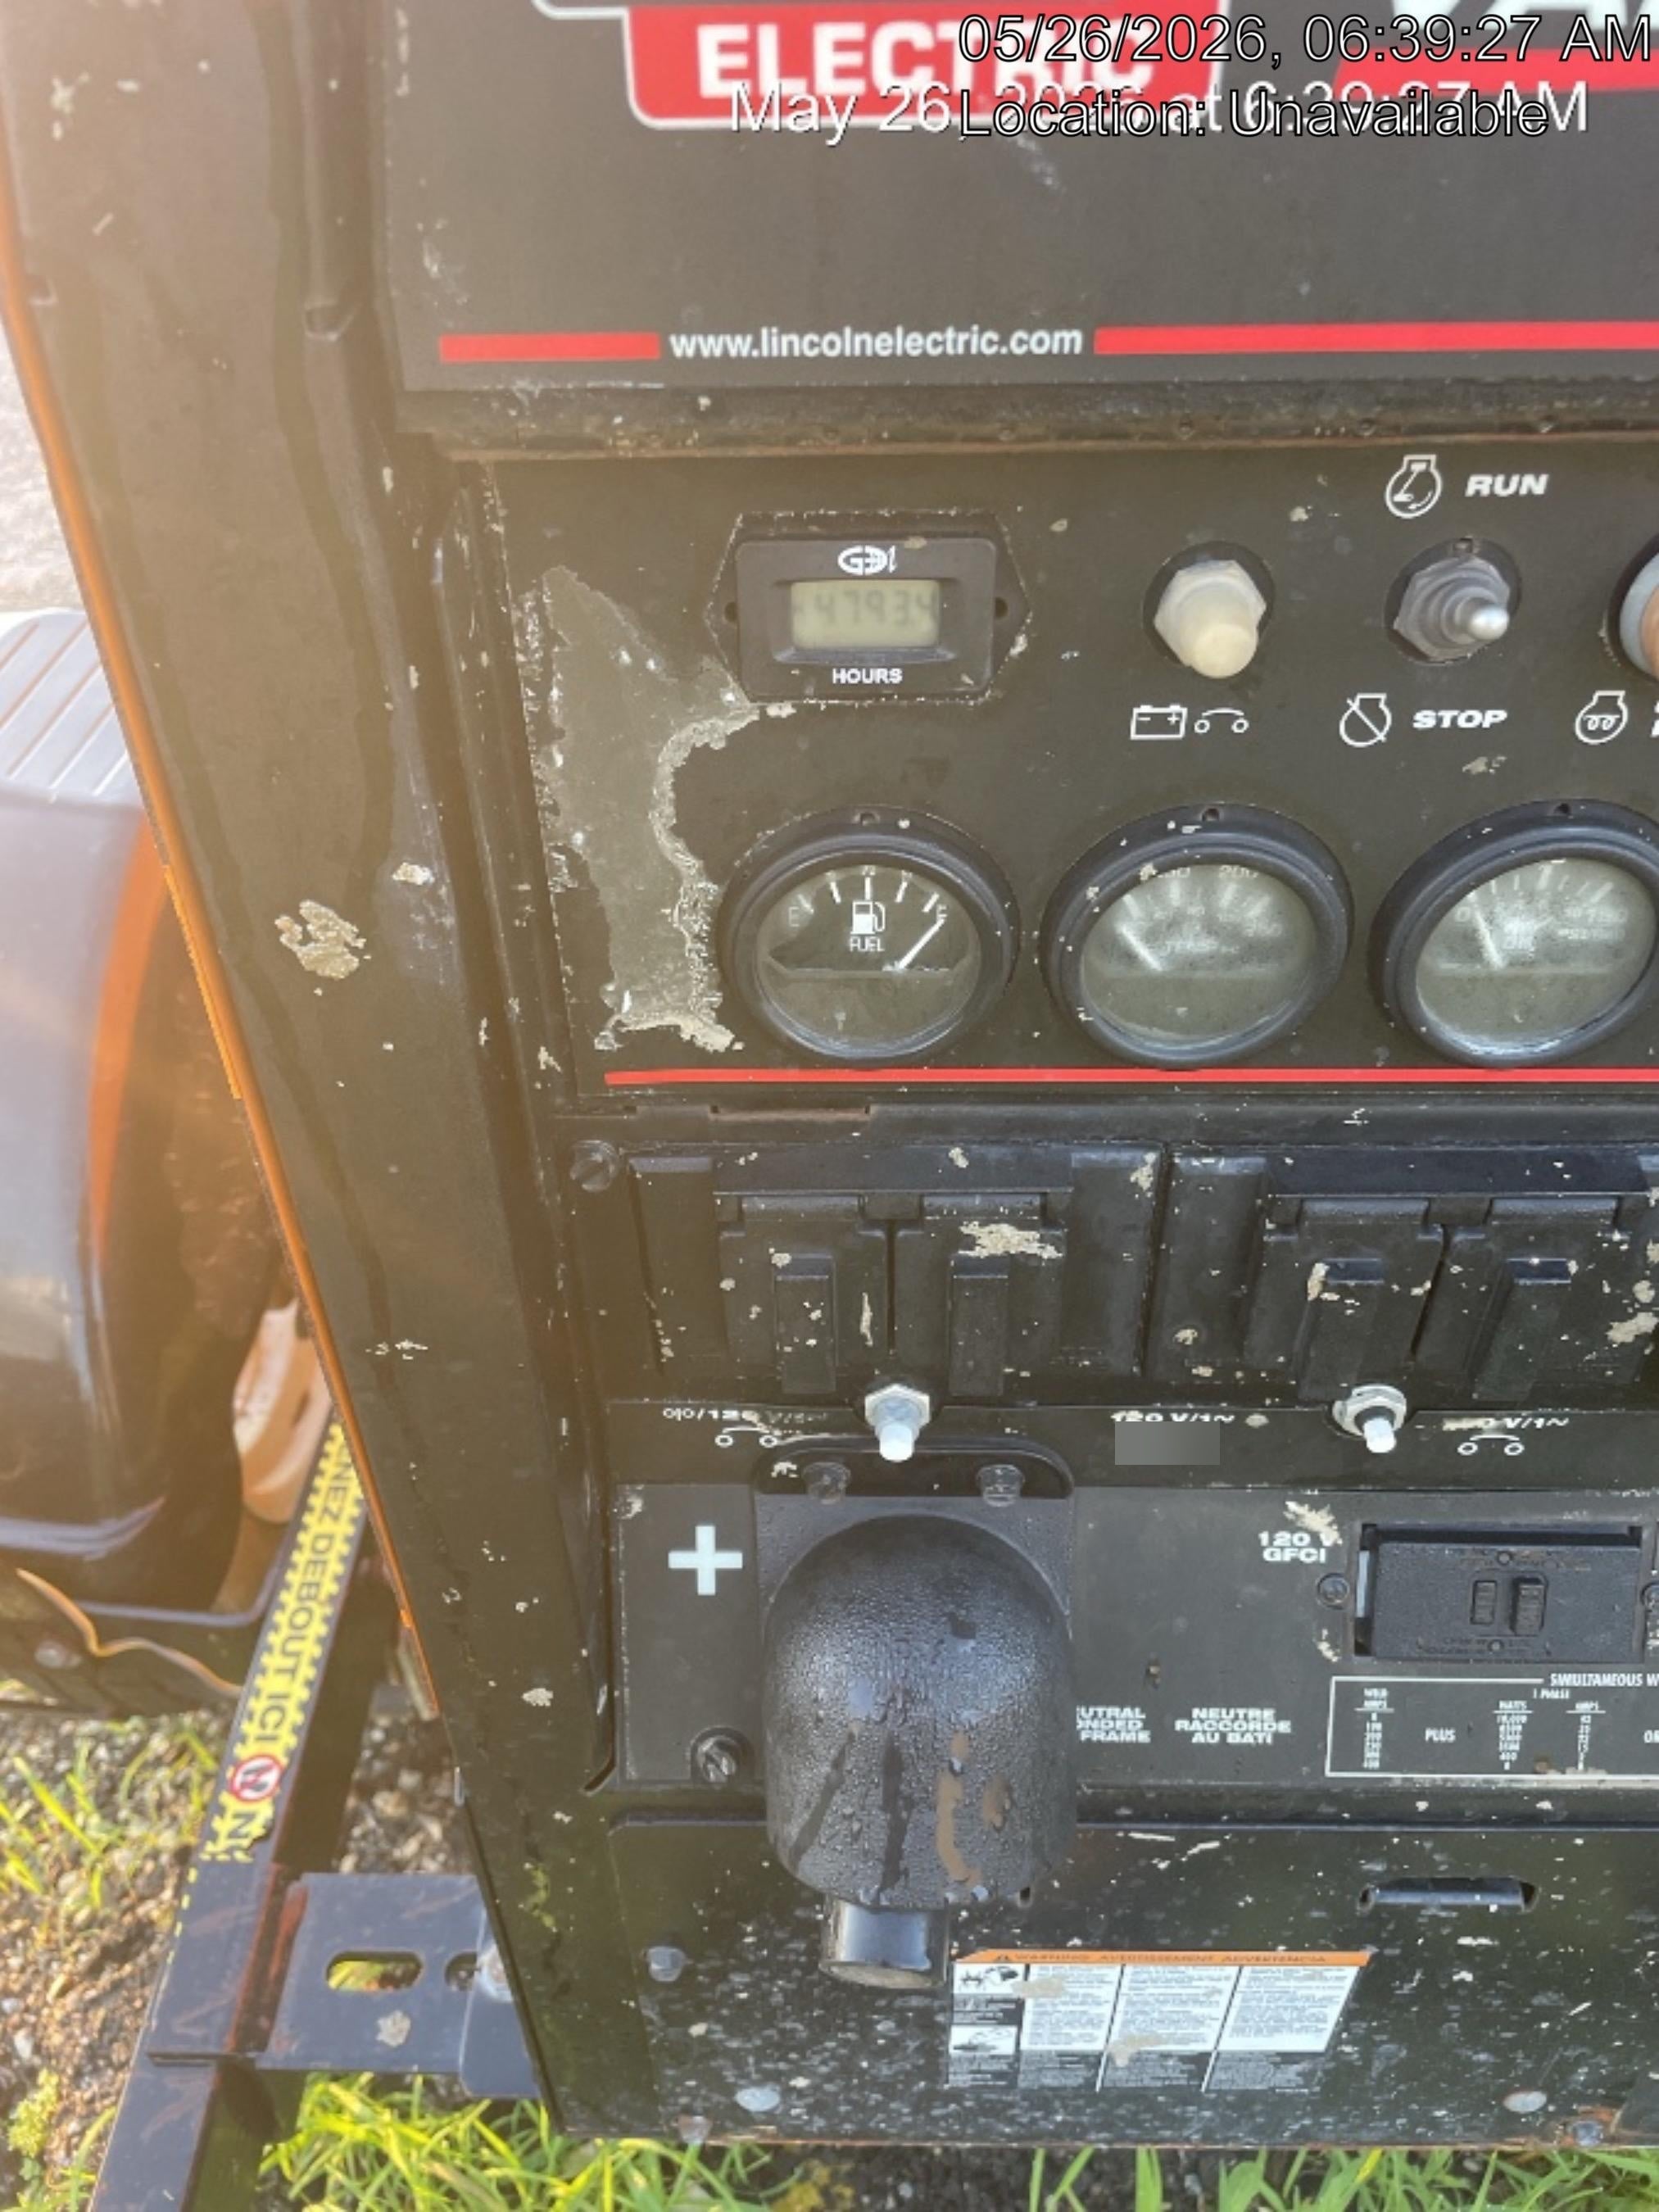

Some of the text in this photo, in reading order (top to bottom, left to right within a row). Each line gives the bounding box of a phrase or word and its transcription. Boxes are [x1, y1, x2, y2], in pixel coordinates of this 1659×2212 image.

[696, 19, 1154, 98] ELECTRIC
[670, 325, 1083, 358] www.lincolnelectric.com
[1465, 474, 1549, 496] RUN
[832, 668, 903, 683] HOURS
[1413, 709, 1507, 728] STOP
[849, 936, 885, 951] FUEL
[1258, 1530, 1311, 1547] 120
[1262, 1547, 1326, 1563] GFCI
[255, 1445, 352, 1740] NEZ DEBOUT ICI
[1550, 1673, 1643, 1687] SIMULTANEOUS
[1077, 1706, 1146, 1720] UTRAL
[1192, 1707, 1276, 1720] NEUTRE
[1081, 1730, 1151, 1743] FRAME
[1191, 1732, 1221, 1744] AU
[1426, 1728, 1457, 1743] PLUS
